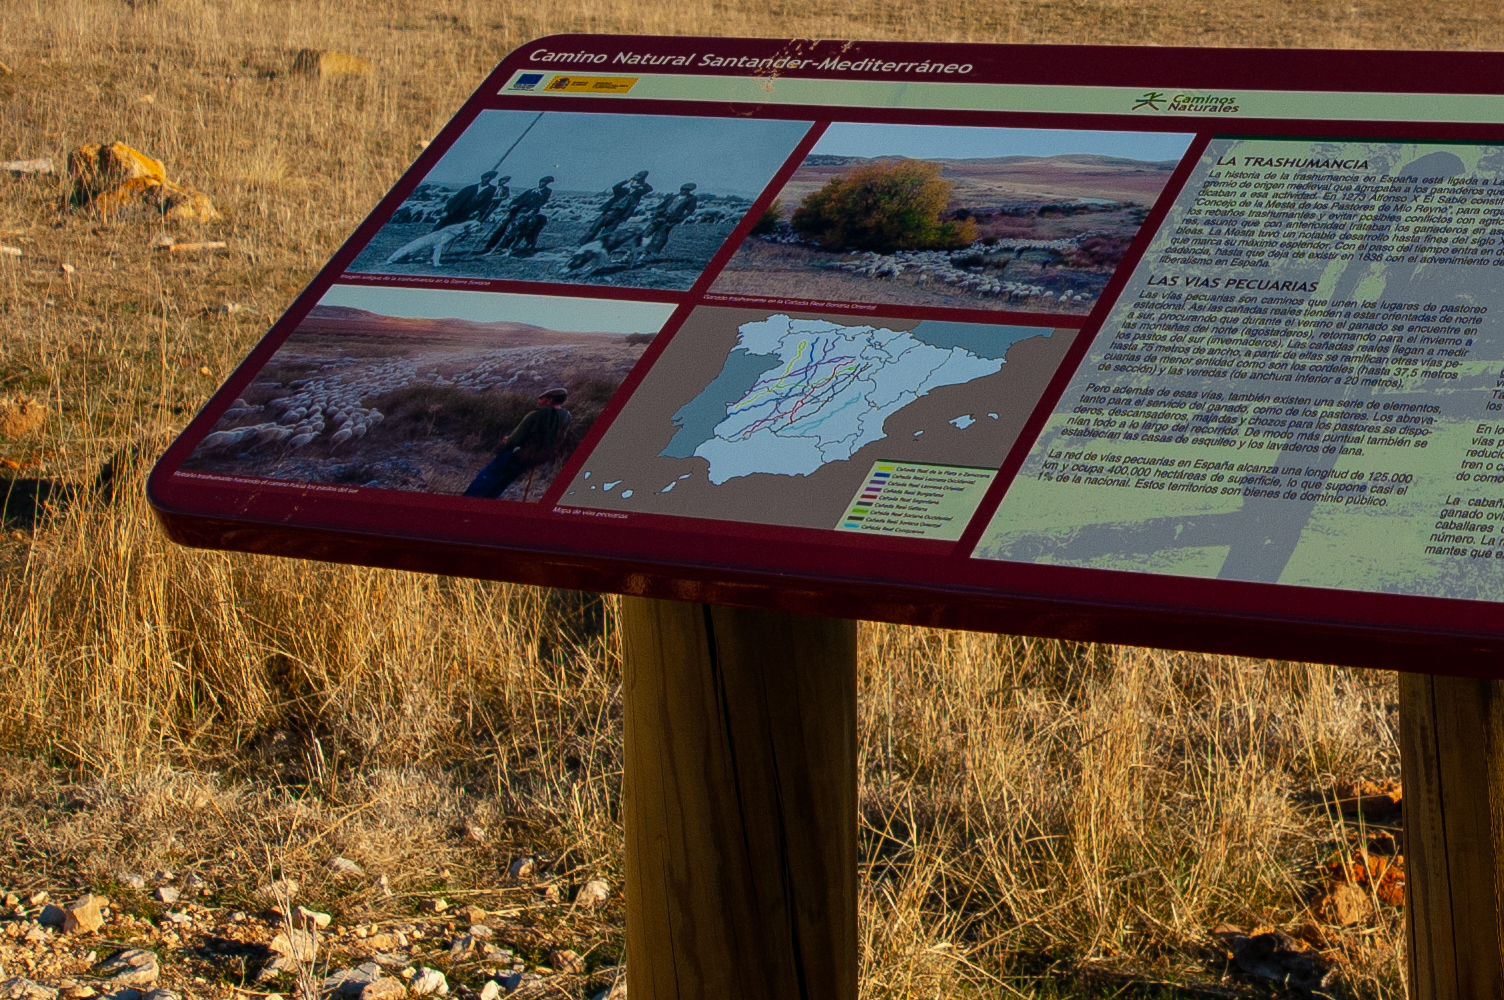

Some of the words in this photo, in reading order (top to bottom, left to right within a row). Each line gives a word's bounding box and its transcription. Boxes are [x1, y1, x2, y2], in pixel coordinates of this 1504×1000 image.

[529, 49, 608, 64] Camino
[612, 51, 697, 66] Natural
[697, 53, 974, 75] Santander-Mediterráneo
[1167, 102, 1240, 113] Naturales
[1173, 94, 1236, 105] Caminos
[1216, 156, 1237, 166] LA
[1244, 156, 1370, 171] TRASHUMANCIA
[1208, 170, 1222, 178] La
[1224, 170, 1261, 180] historia
[1263, 171, 1277, 180] de
[1279, 172, 1290, 180] la
[1363, 174, 1377, 184] en
[1377, 175, 1418, 185] España
[1422, 176, 1445, 184] está
[1447, 177, 1478, 187] ligada
[1146, 274, 1180, 287] LAS
[1185, 276, 1222, 289] VIAS
[1223, 278, 1320, 293] PECUARIAS
[1138, 289, 1159, 300] Las
[1161, 291, 1183, 301] vías
[1237, 295, 1258, 304] son
[1260, 296, 1305, 306] caminos
[1307, 299, 1328, 308] que
[1330, 300, 1358, 309] unen
[1360, 299, 1378, 309] los
[1379, 300, 1420, 311] lugares
[1422, 302, 1437, 312] de
[1438, 304, 1488, 314] pastoreo
[1085, 383, 1111, 394] Pero
[1112, 385, 1155, 396] además
[1156, 387, 1171, 397] de
[1173, 390, 1199, 399] esas
[1201, 390, 1225, 402] vías,
[1227, 392, 1271, 404] también
[1273, 395, 1312, 406] existen
[1313, 398, 1334, 408] una
[1336, 399, 1364, 409] serie
[1365, 400, 1380, 410] de
[1476, 424, 1493, 435] En
[1047, 449, 1063, 459] La
[1062, 451, 1084, 462] red
[1083, 451, 1098, 461] de
[1099, 453, 1123, 463] vías
[1177, 459, 1192, 468] en
[1193, 458, 1235, 471] España
[1236, 462, 1280, 474] alcanza
[1280, 467, 1302, 476] una
[1303, 466, 1350, 479] longitud
[1349, 470, 1365, 481] de
[1367, 471, 1414, 484] 125.000
[1041, 460, 1059, 472] km
[1058, 463, 1070, 473] y
[1068, 462, 1105, 475] ocupa
[1107, 464, 1152, 478] 400.000
[1209, 472, 1225, 483] de
[1286, 477, 1298, 488] lo
[1300, 480, 1322, 490] que
[1324, 482, 1367, 493] supone
[1369, 483, 1395, 495] casi
[1396, 485, 1409, 496] el
[1443, 494, 1461, 506] La
